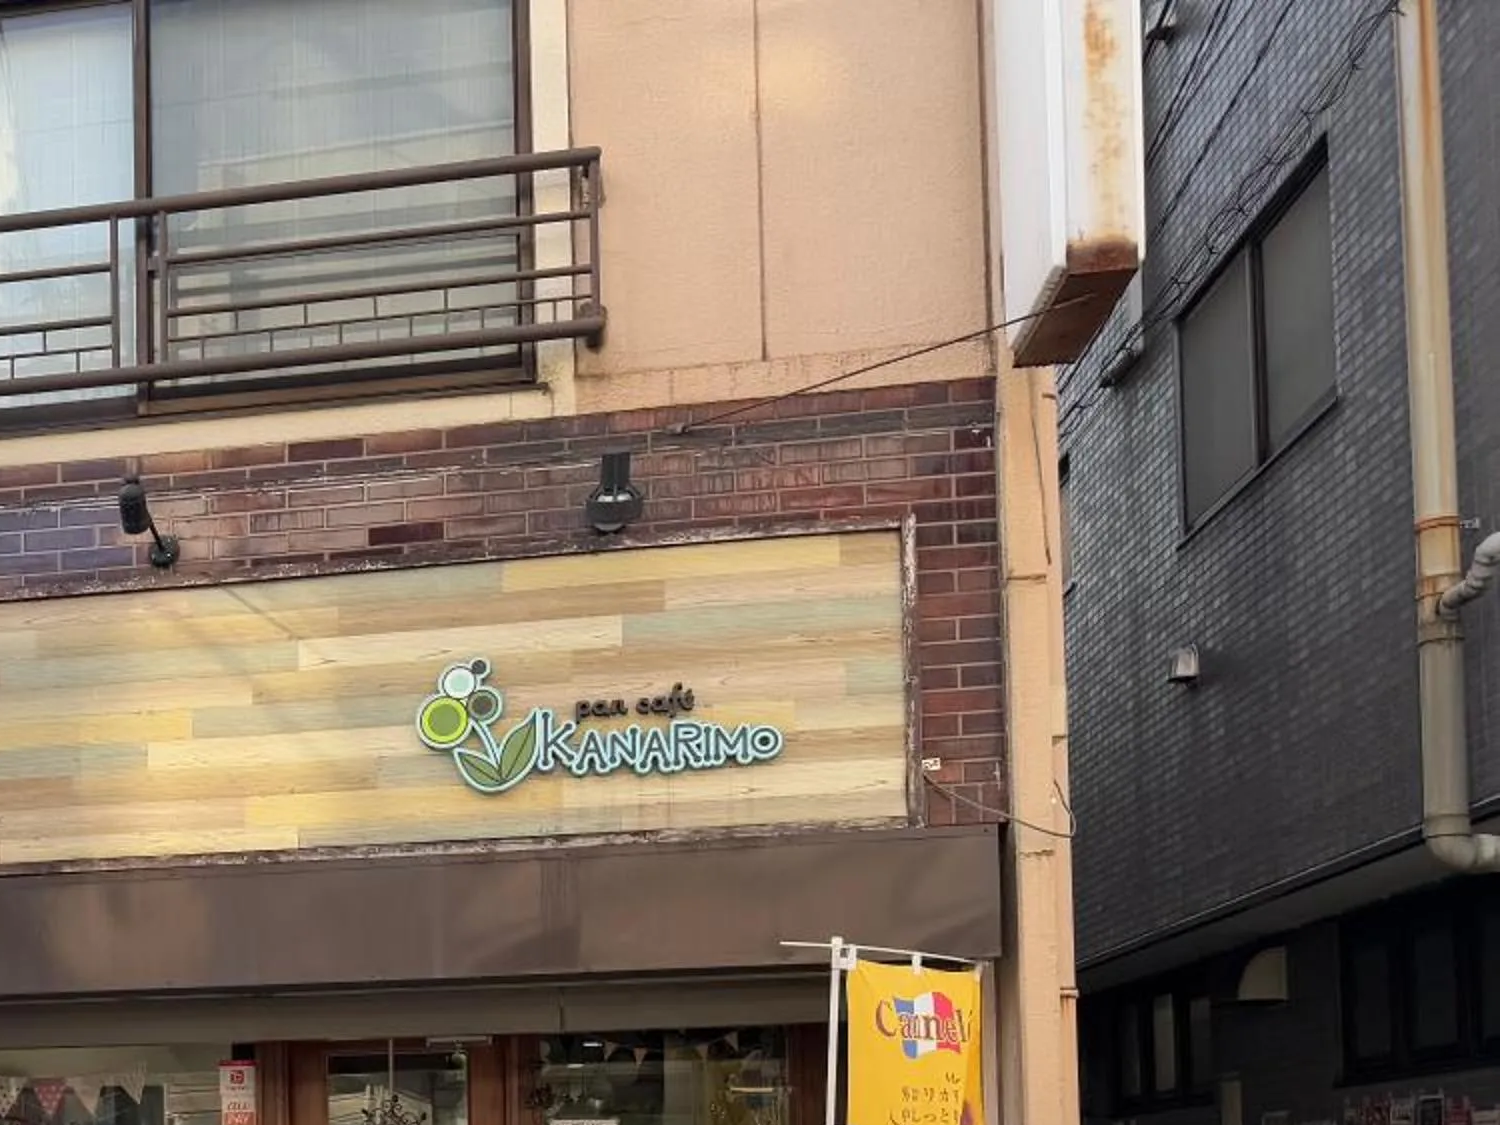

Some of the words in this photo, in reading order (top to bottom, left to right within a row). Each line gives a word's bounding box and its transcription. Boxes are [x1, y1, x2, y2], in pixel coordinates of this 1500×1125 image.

[575, 697, 628, 724] pan
[637, 683, 696, 717] café
[539, 710, 783, 773] KANARIMO
